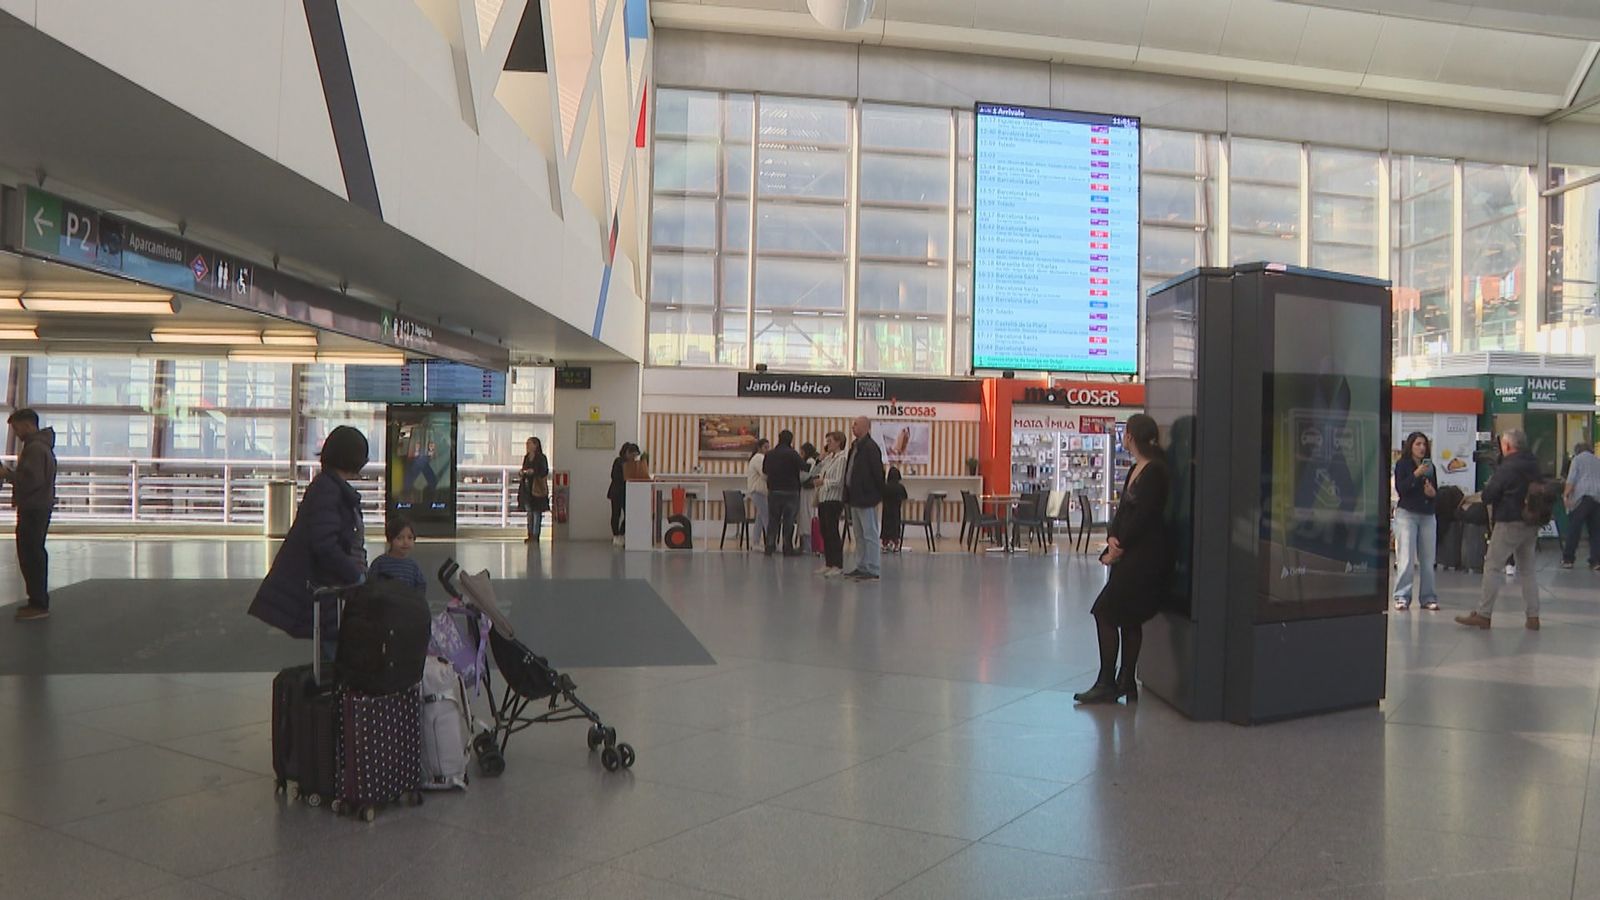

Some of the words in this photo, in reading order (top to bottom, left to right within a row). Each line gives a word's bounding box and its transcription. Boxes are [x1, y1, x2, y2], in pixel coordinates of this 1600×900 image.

[129, 232, 183, 263] Aparcamiento
[745, 380, 786, 393] Jamón
[790, 381, 832, 395] Ibérico
[1495, 386, 1523, 396] CHANGE
[1527, 379, 1566, 390] HANGE
